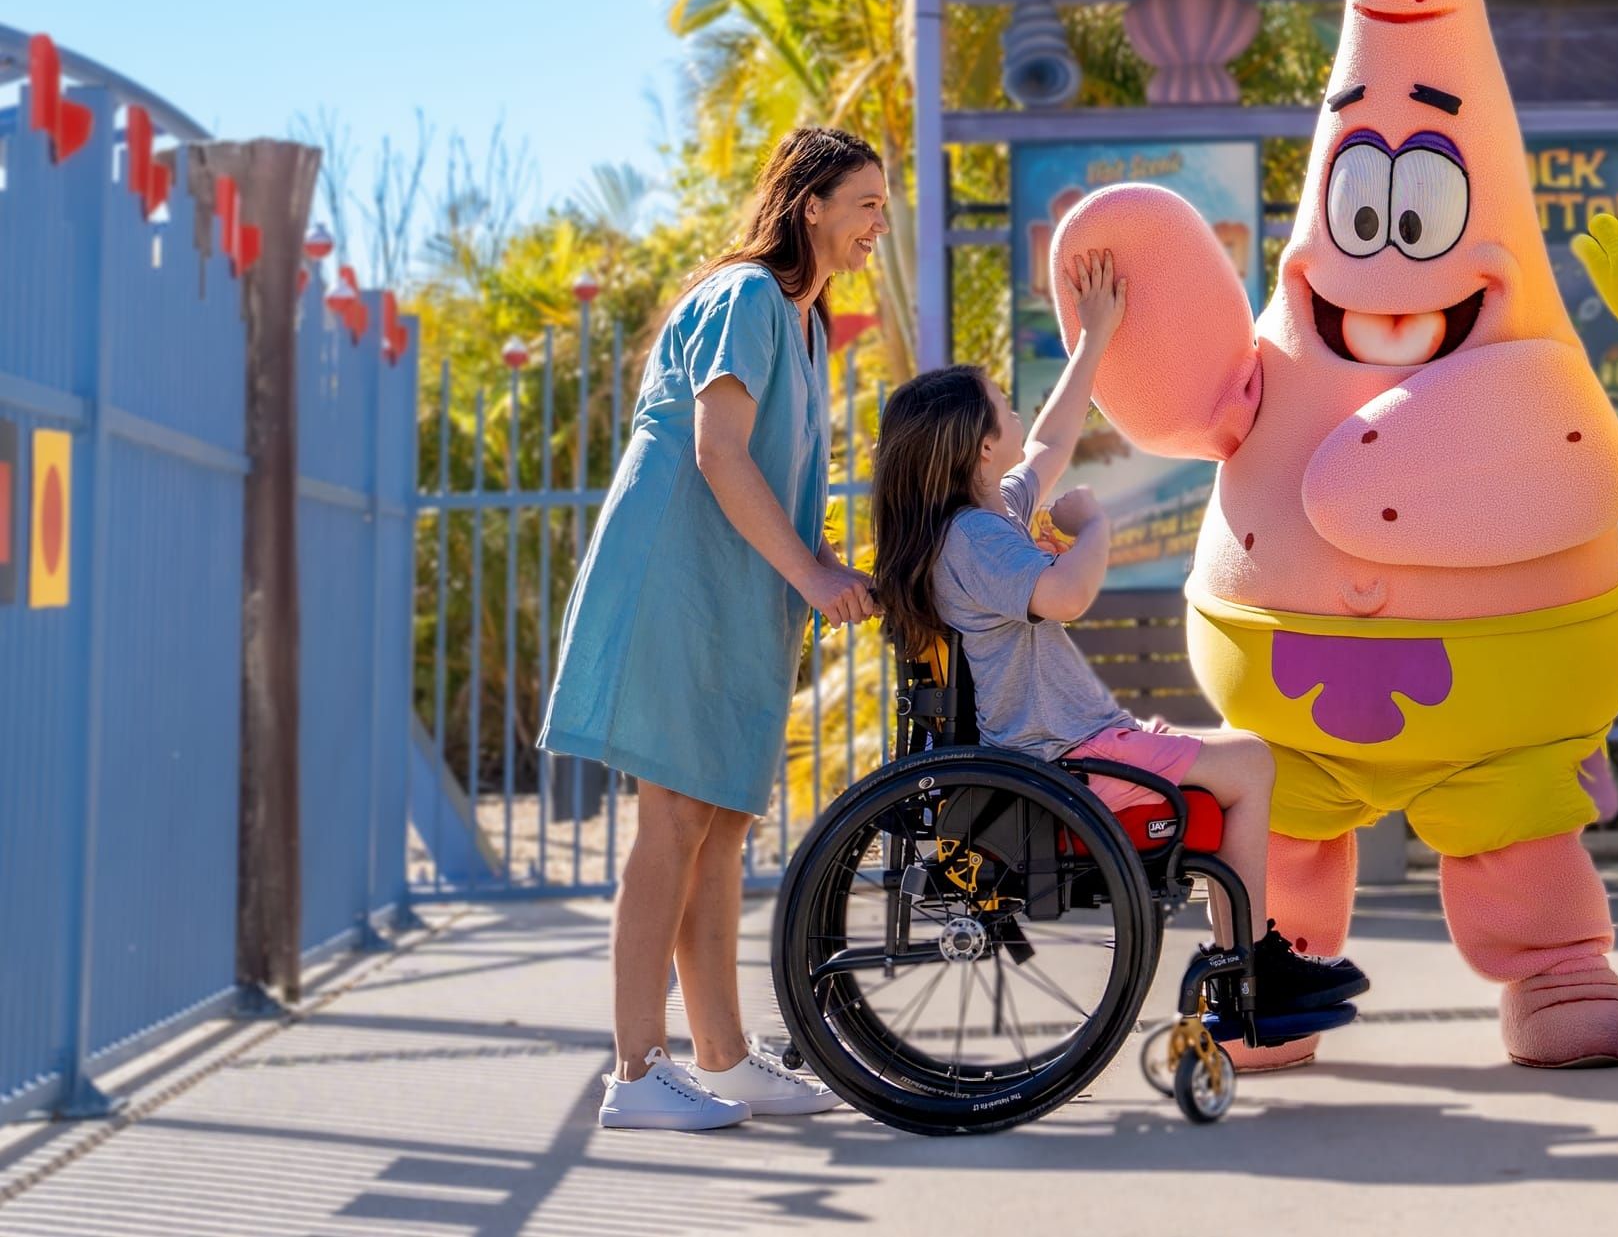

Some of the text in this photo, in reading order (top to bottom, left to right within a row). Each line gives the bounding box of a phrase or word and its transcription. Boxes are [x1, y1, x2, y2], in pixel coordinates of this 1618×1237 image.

[1526, 148, 1606, 189] CK
[1150, 822, 1166, 831] JAY
[1010, 1093, 1021, 1101] The
